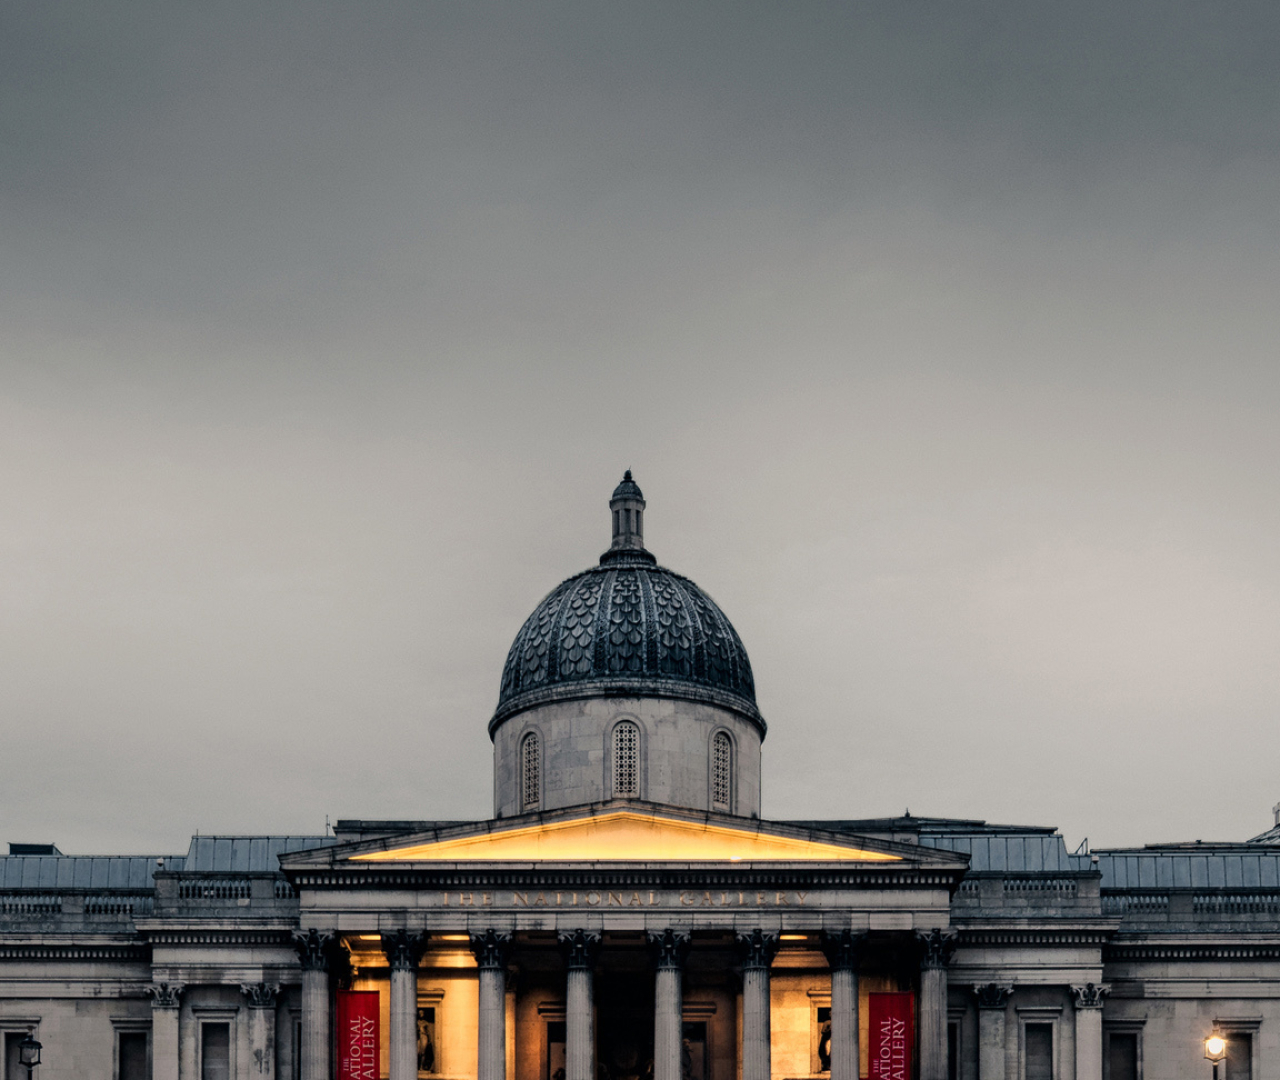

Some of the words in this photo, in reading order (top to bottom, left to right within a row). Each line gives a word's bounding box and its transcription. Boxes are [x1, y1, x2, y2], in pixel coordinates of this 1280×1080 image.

[440, 891, 493, 906] THE
[513, 891, 661, 906] NATIONAL
[679, 891, 809, 906] GALLERY
